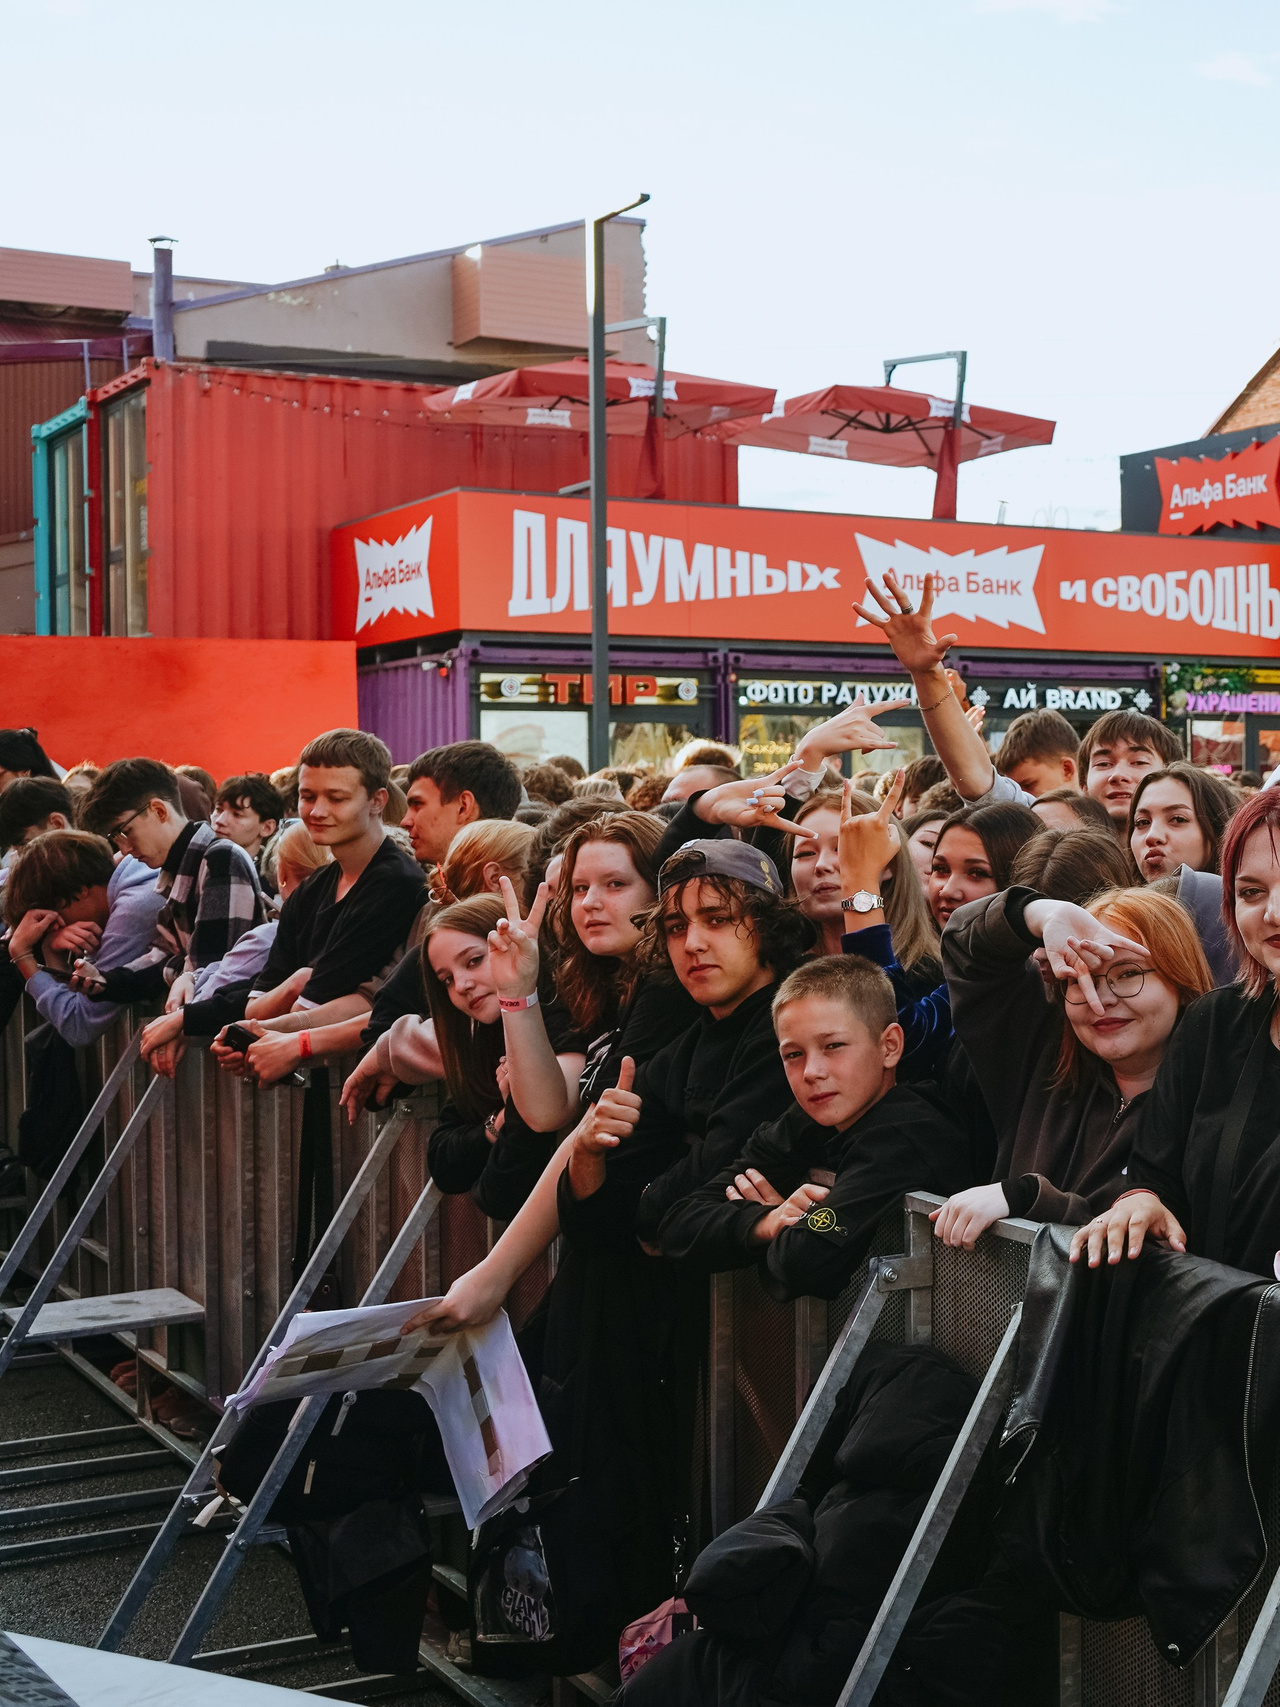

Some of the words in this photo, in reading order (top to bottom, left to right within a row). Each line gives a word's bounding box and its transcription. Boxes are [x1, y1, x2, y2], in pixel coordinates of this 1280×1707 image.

[1169, 478, 1223, 519] Альфа
[1225, 473, 1268, 499] Банк
[364, 562, 397, 600] Альфа
[398, 558, 423, 584] Банк
[966, 571, 1022, 596] Банк
[746, 681, 814, 705] ФОТО
[1002, 682, 1037, 709] АЙ
[1045, 689, 1122, 710] BRAND
